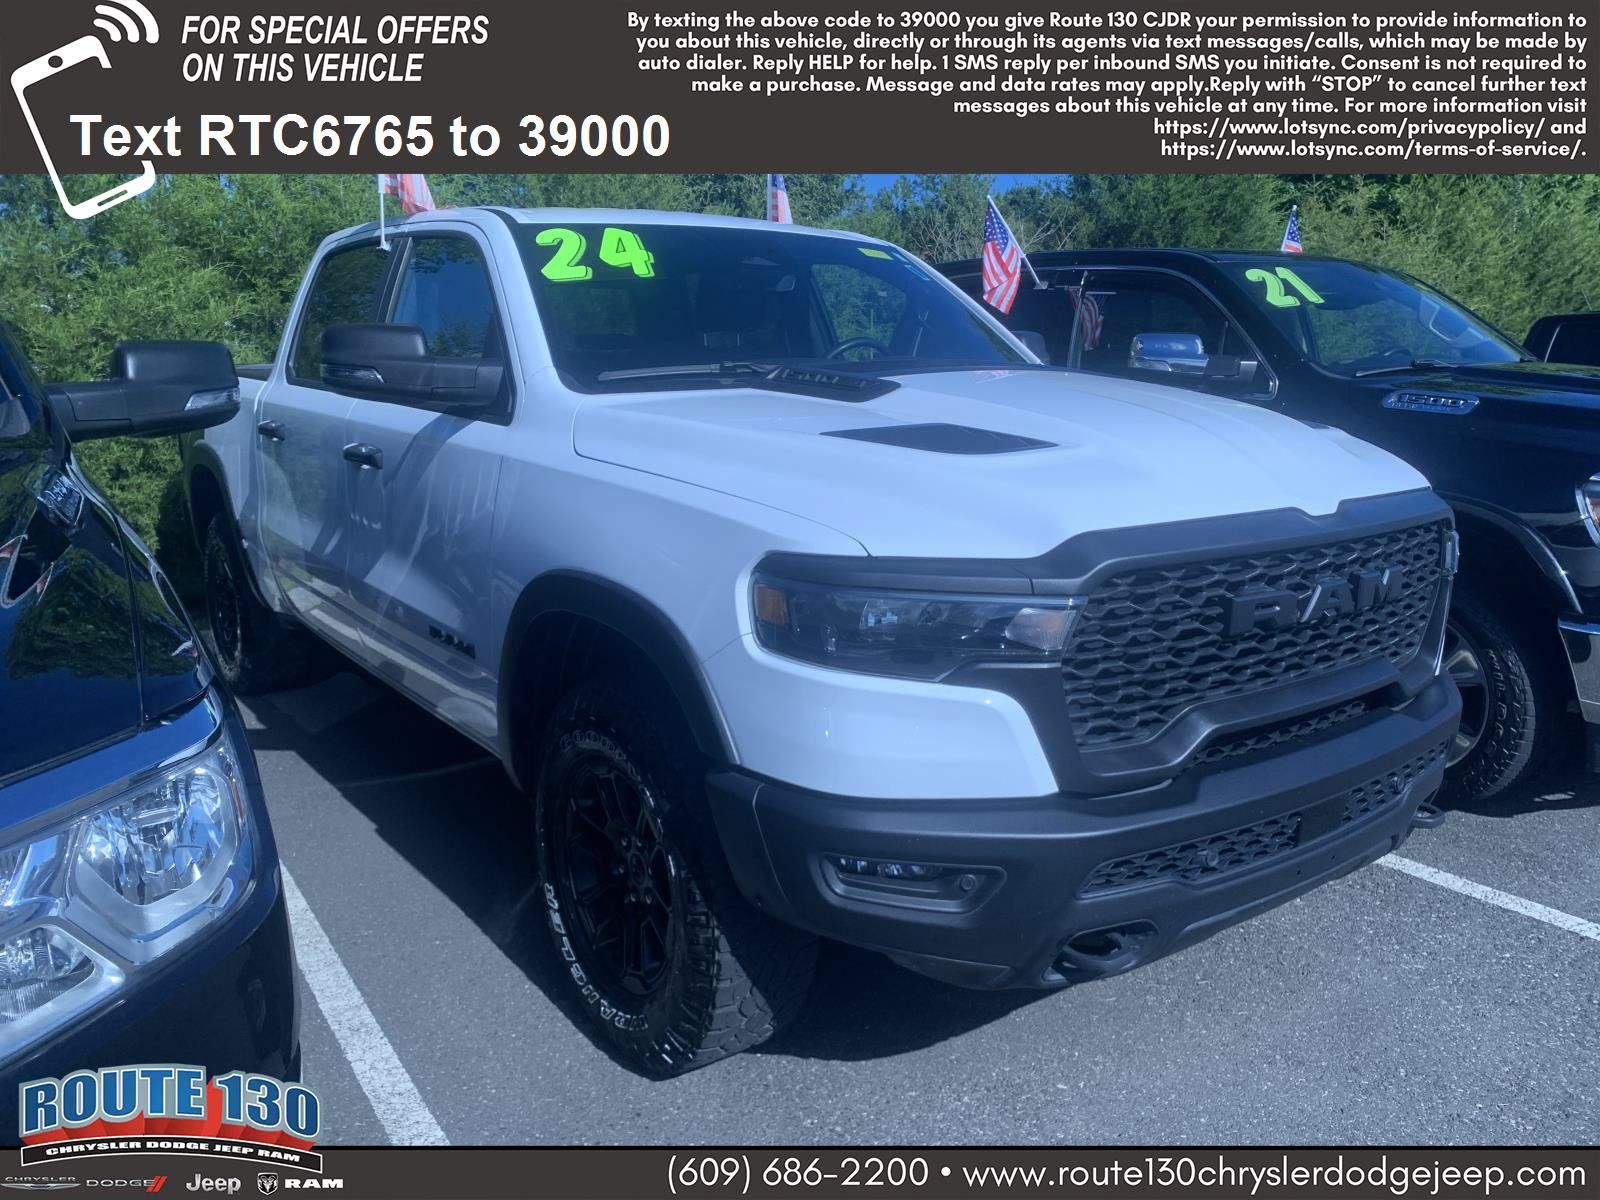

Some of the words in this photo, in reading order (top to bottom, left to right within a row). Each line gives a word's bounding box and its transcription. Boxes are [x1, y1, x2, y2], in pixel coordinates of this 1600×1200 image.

[535, 227, 656, 282] 24
[1244, 266, 1326, 308] 21
[1224, 564, 1404, 637] RAM
